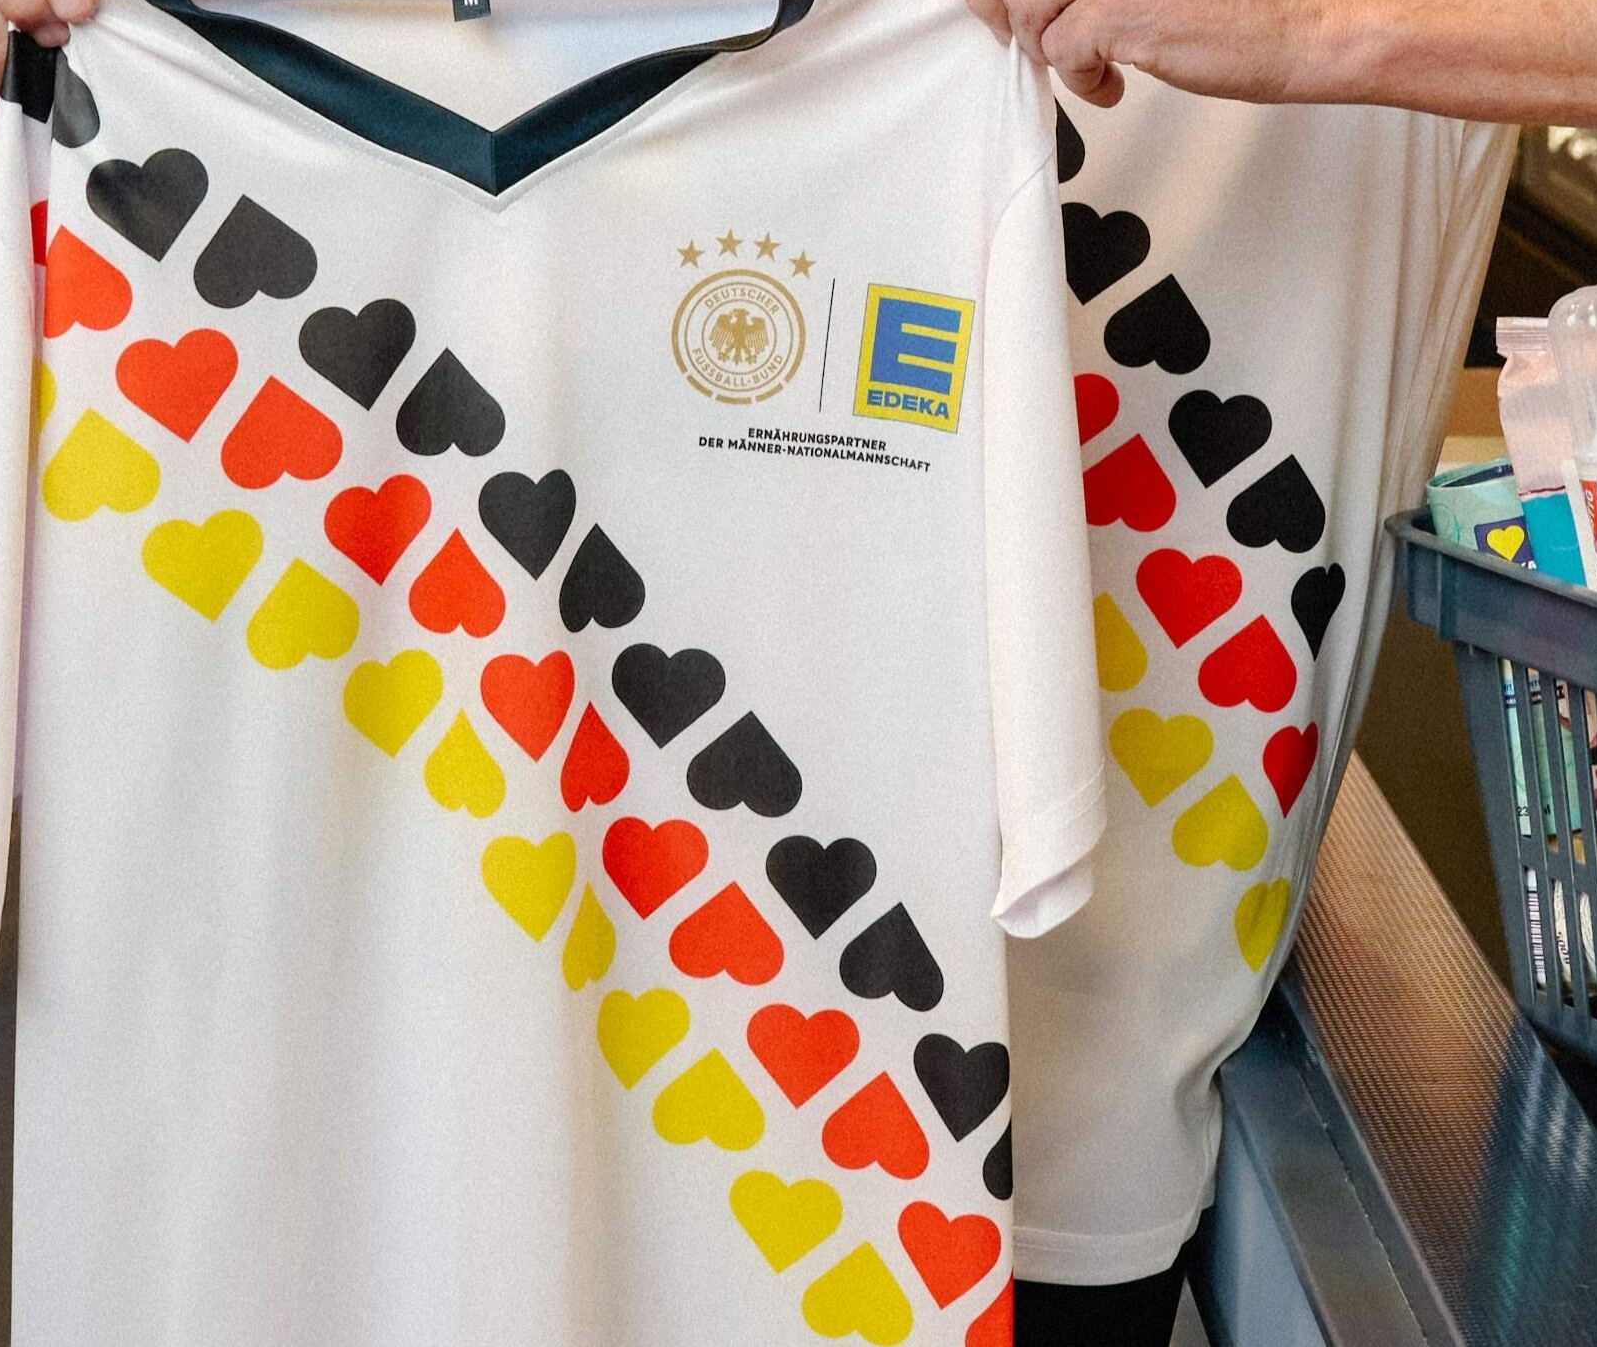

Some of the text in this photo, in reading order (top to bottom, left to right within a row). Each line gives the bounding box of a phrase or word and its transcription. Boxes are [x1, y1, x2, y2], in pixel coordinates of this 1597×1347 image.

[704, 287, 780, 315] DEUTSCHER
[692, 347, 784, 387] FUSSBALL-BUND
[866, 389, 950, 420] EDEKA
[698, 436, 931, 472] DER MÄNNER-NATIONALMANNSCHAFT
[748, 427, 887, 451] ERNÄHRUNGSPARTNER
